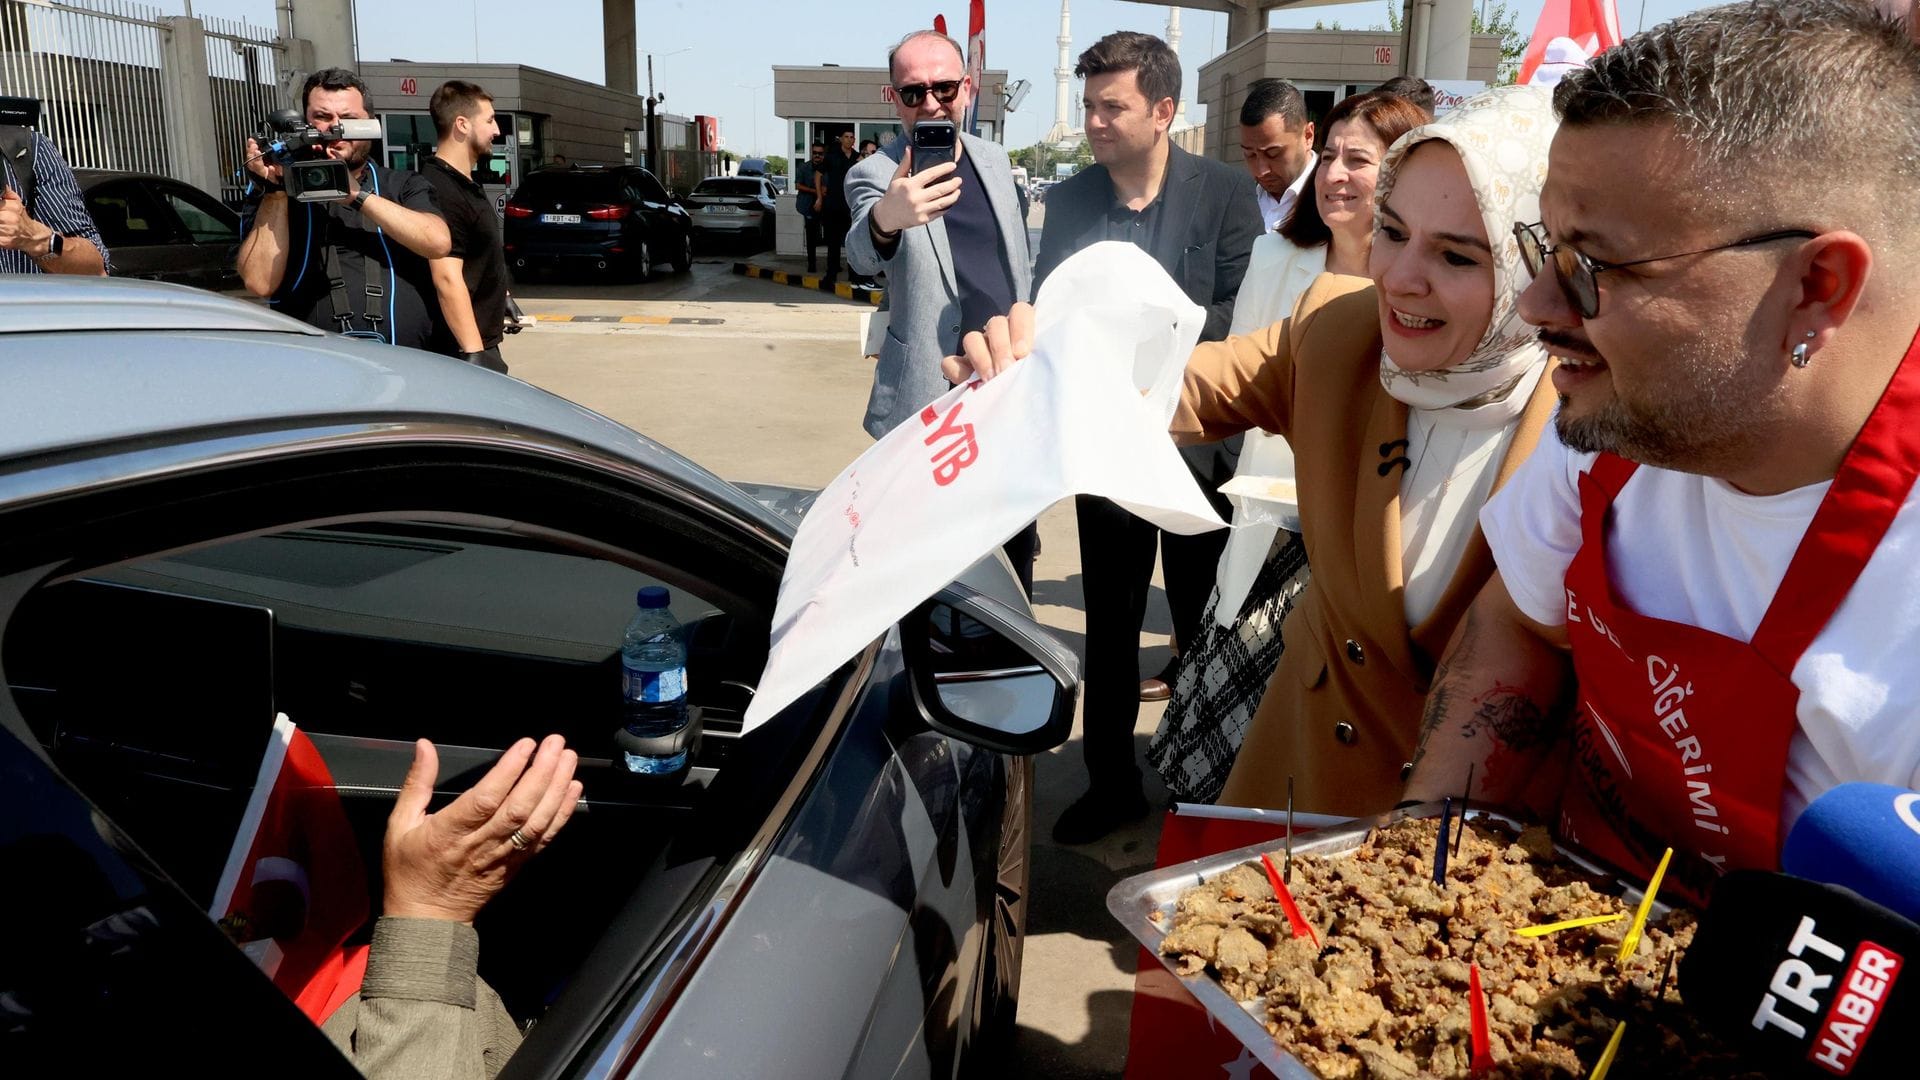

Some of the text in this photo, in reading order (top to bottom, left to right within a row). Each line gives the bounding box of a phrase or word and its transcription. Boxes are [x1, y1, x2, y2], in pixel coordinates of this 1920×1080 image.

[1375, 46, 1391, 64] 106
[401, 78, 416, 94] 40
[882, 86, 894, 102] 10
[924, 401, 979, 487] YTB
[1751, 914, 1846, 1039] TRT
[1815, 948, 1897, 1071] HABER
